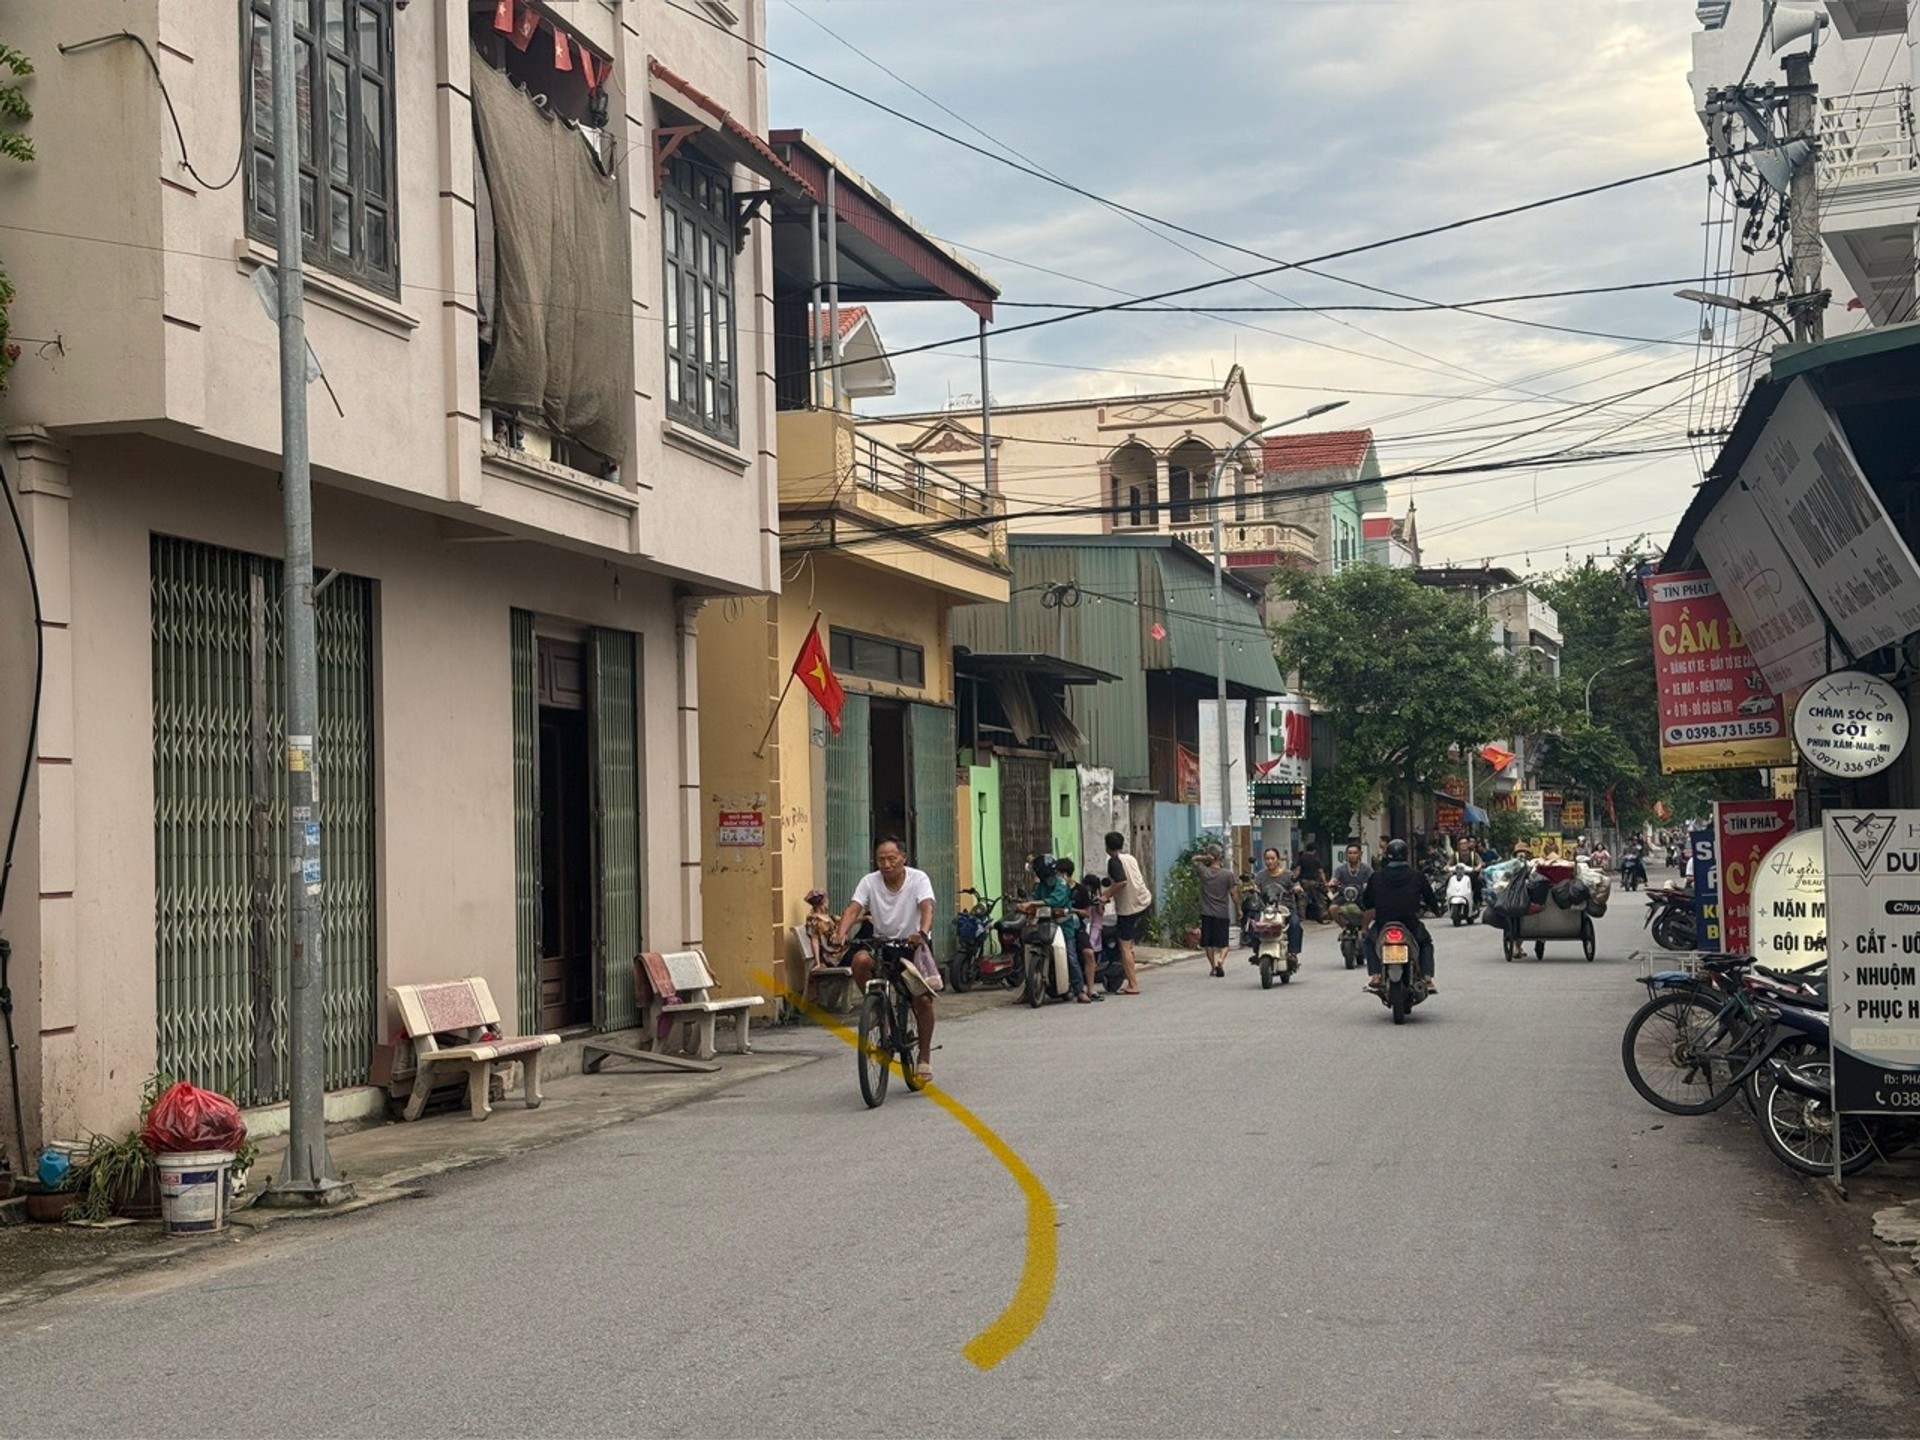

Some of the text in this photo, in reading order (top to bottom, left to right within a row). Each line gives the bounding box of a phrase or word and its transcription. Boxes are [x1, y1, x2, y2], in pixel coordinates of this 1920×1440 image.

[1659, 606, 1721, 655] CẦM
[1808, 705, 1893, 723] CHĂM SÓC DA
[1685, 720, 1773, 740] 0398.731.555
[1832, 721, 1868, 740] GỘI
[1806, 738, 1831, 748] PHUN
[1816, 752, 1841, 770] 0971
[1843, 763, 1864, 772] 336
[1730, 814, 1777, 830] TÍN PHÁT
[1886, 852, 1920, 873] DU
[1773, 898, 1806, 921] NẶN
[1773, 931, 1799, 955] GỘI
[1856, 928, 1887, 954] CẮT
[1856, 963, 1916, 990] NHUỘM
[1857, 999, 1904, 1023] PHỤC
